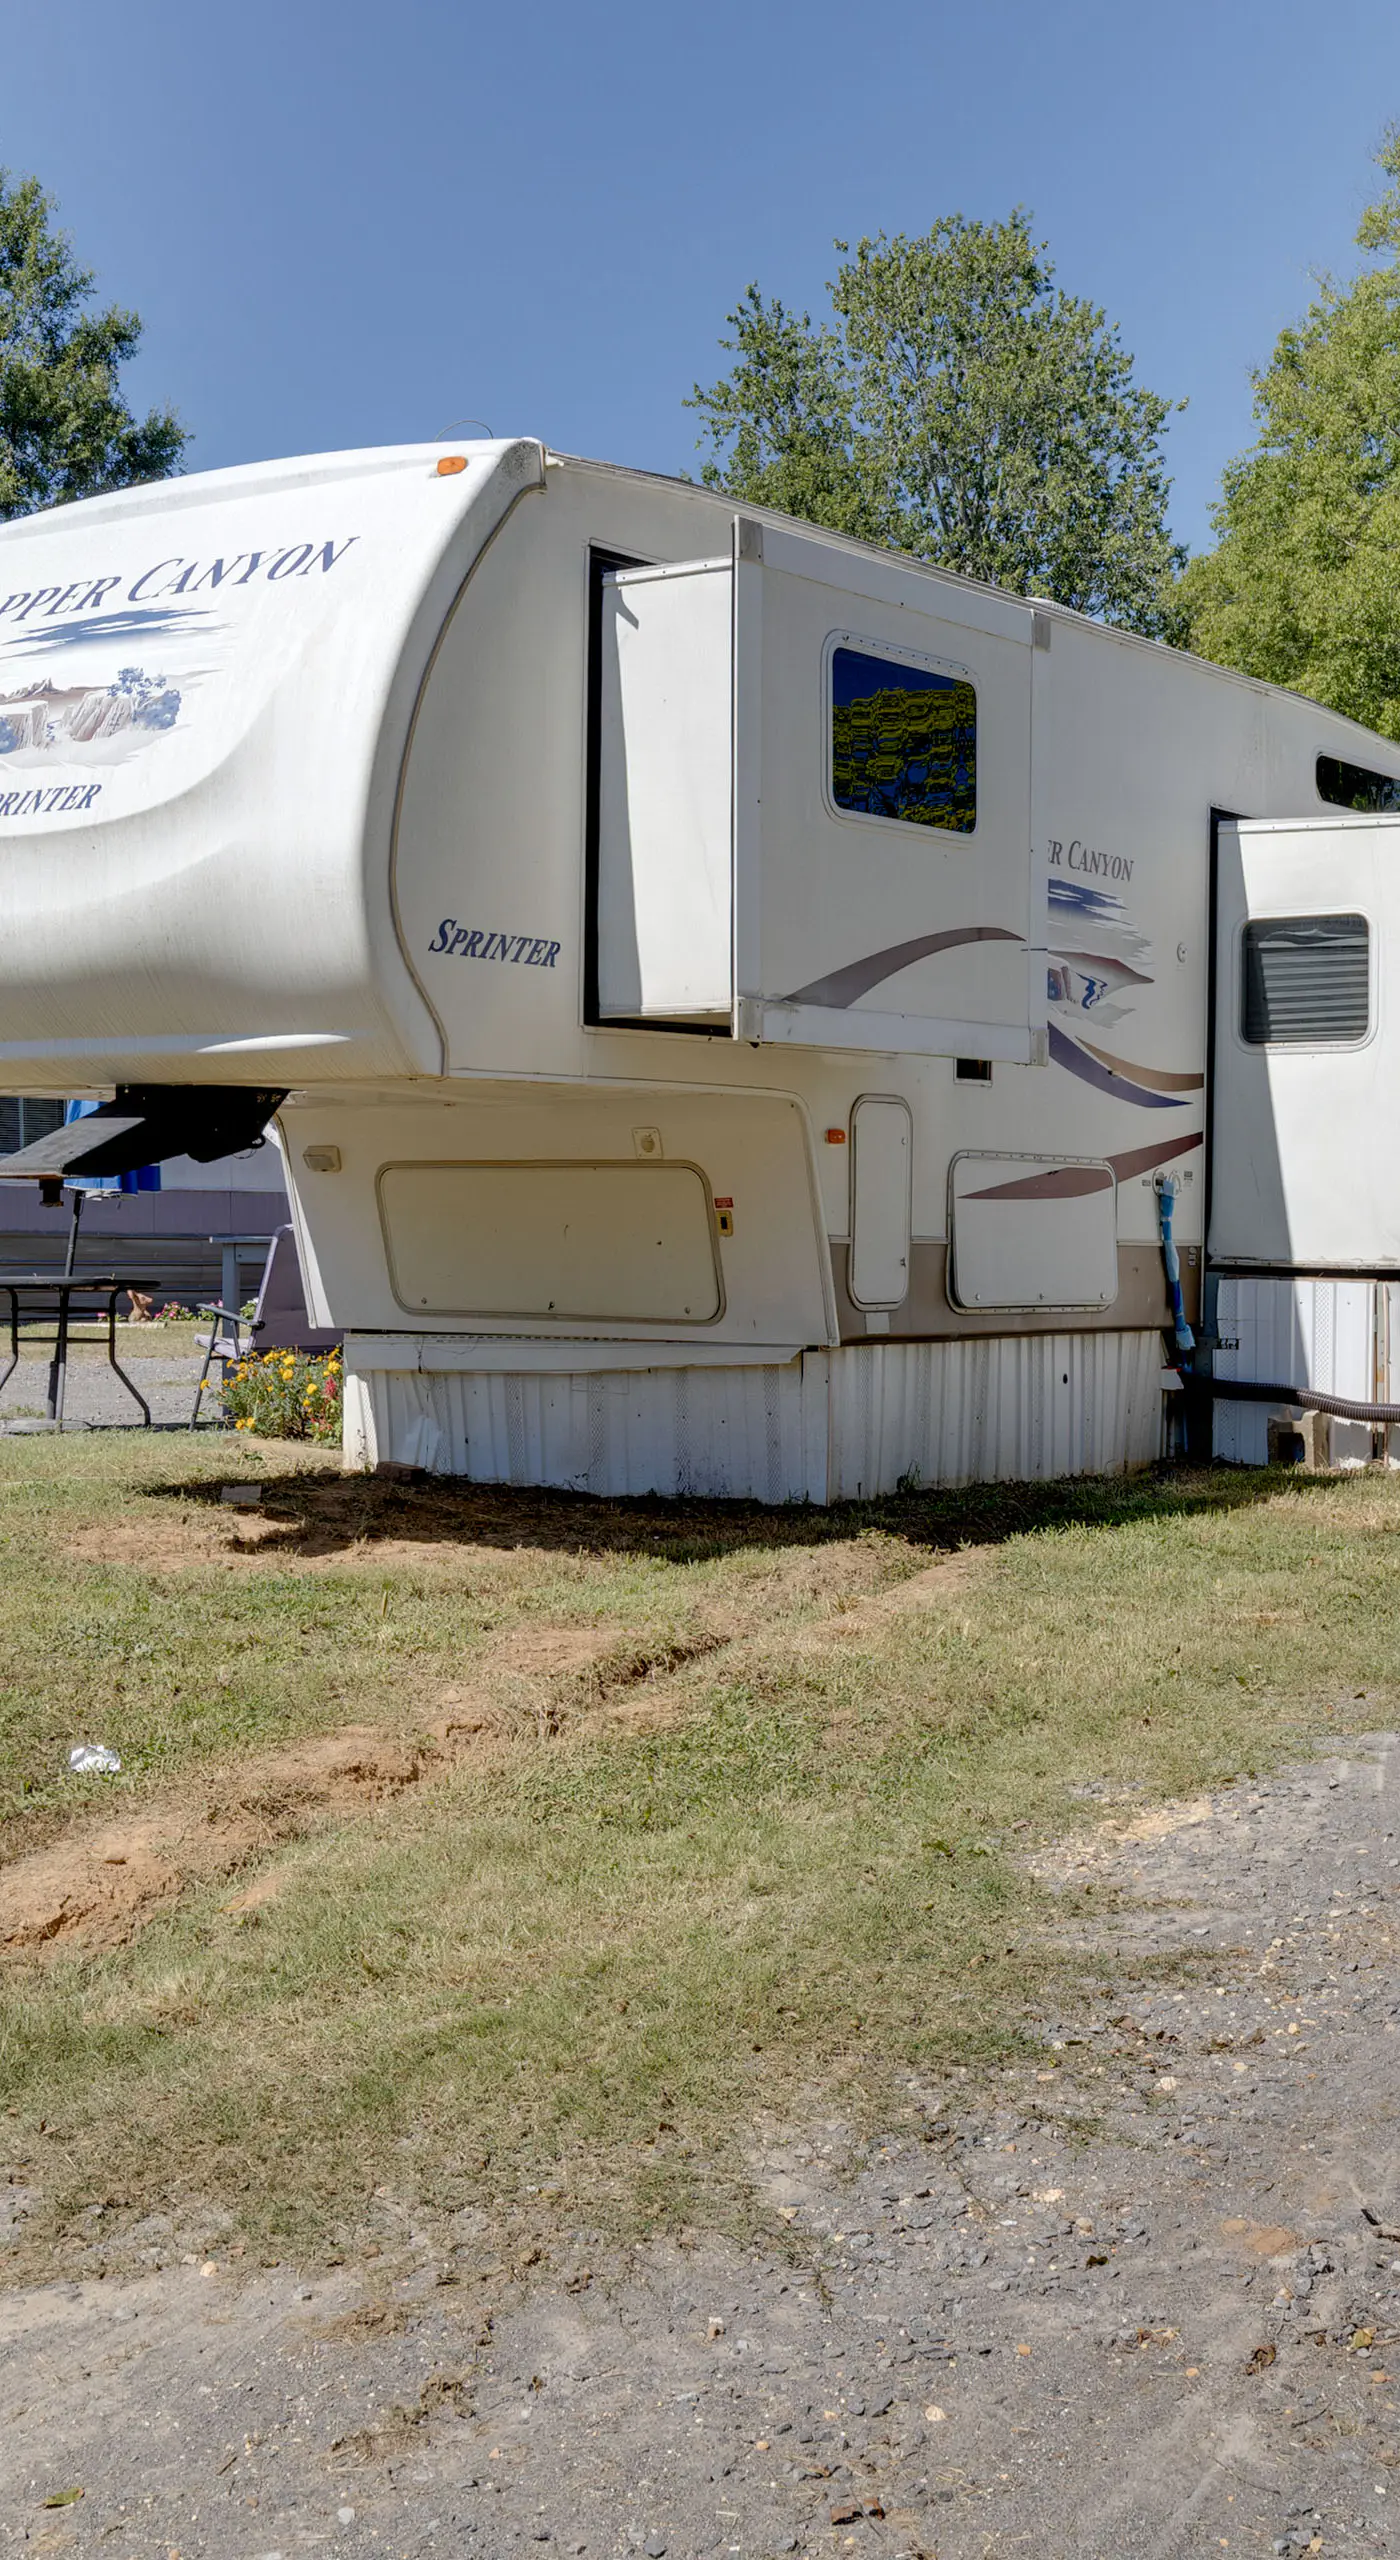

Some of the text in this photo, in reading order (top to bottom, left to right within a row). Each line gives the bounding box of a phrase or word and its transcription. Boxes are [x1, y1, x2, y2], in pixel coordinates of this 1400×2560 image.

[128, 536, 361, 602] CANYON
[0, 784, 102, 816] RINTER
[1068, 840, 1134, 882] CANYON
[428, 918, 561, 968] SPRINTER
